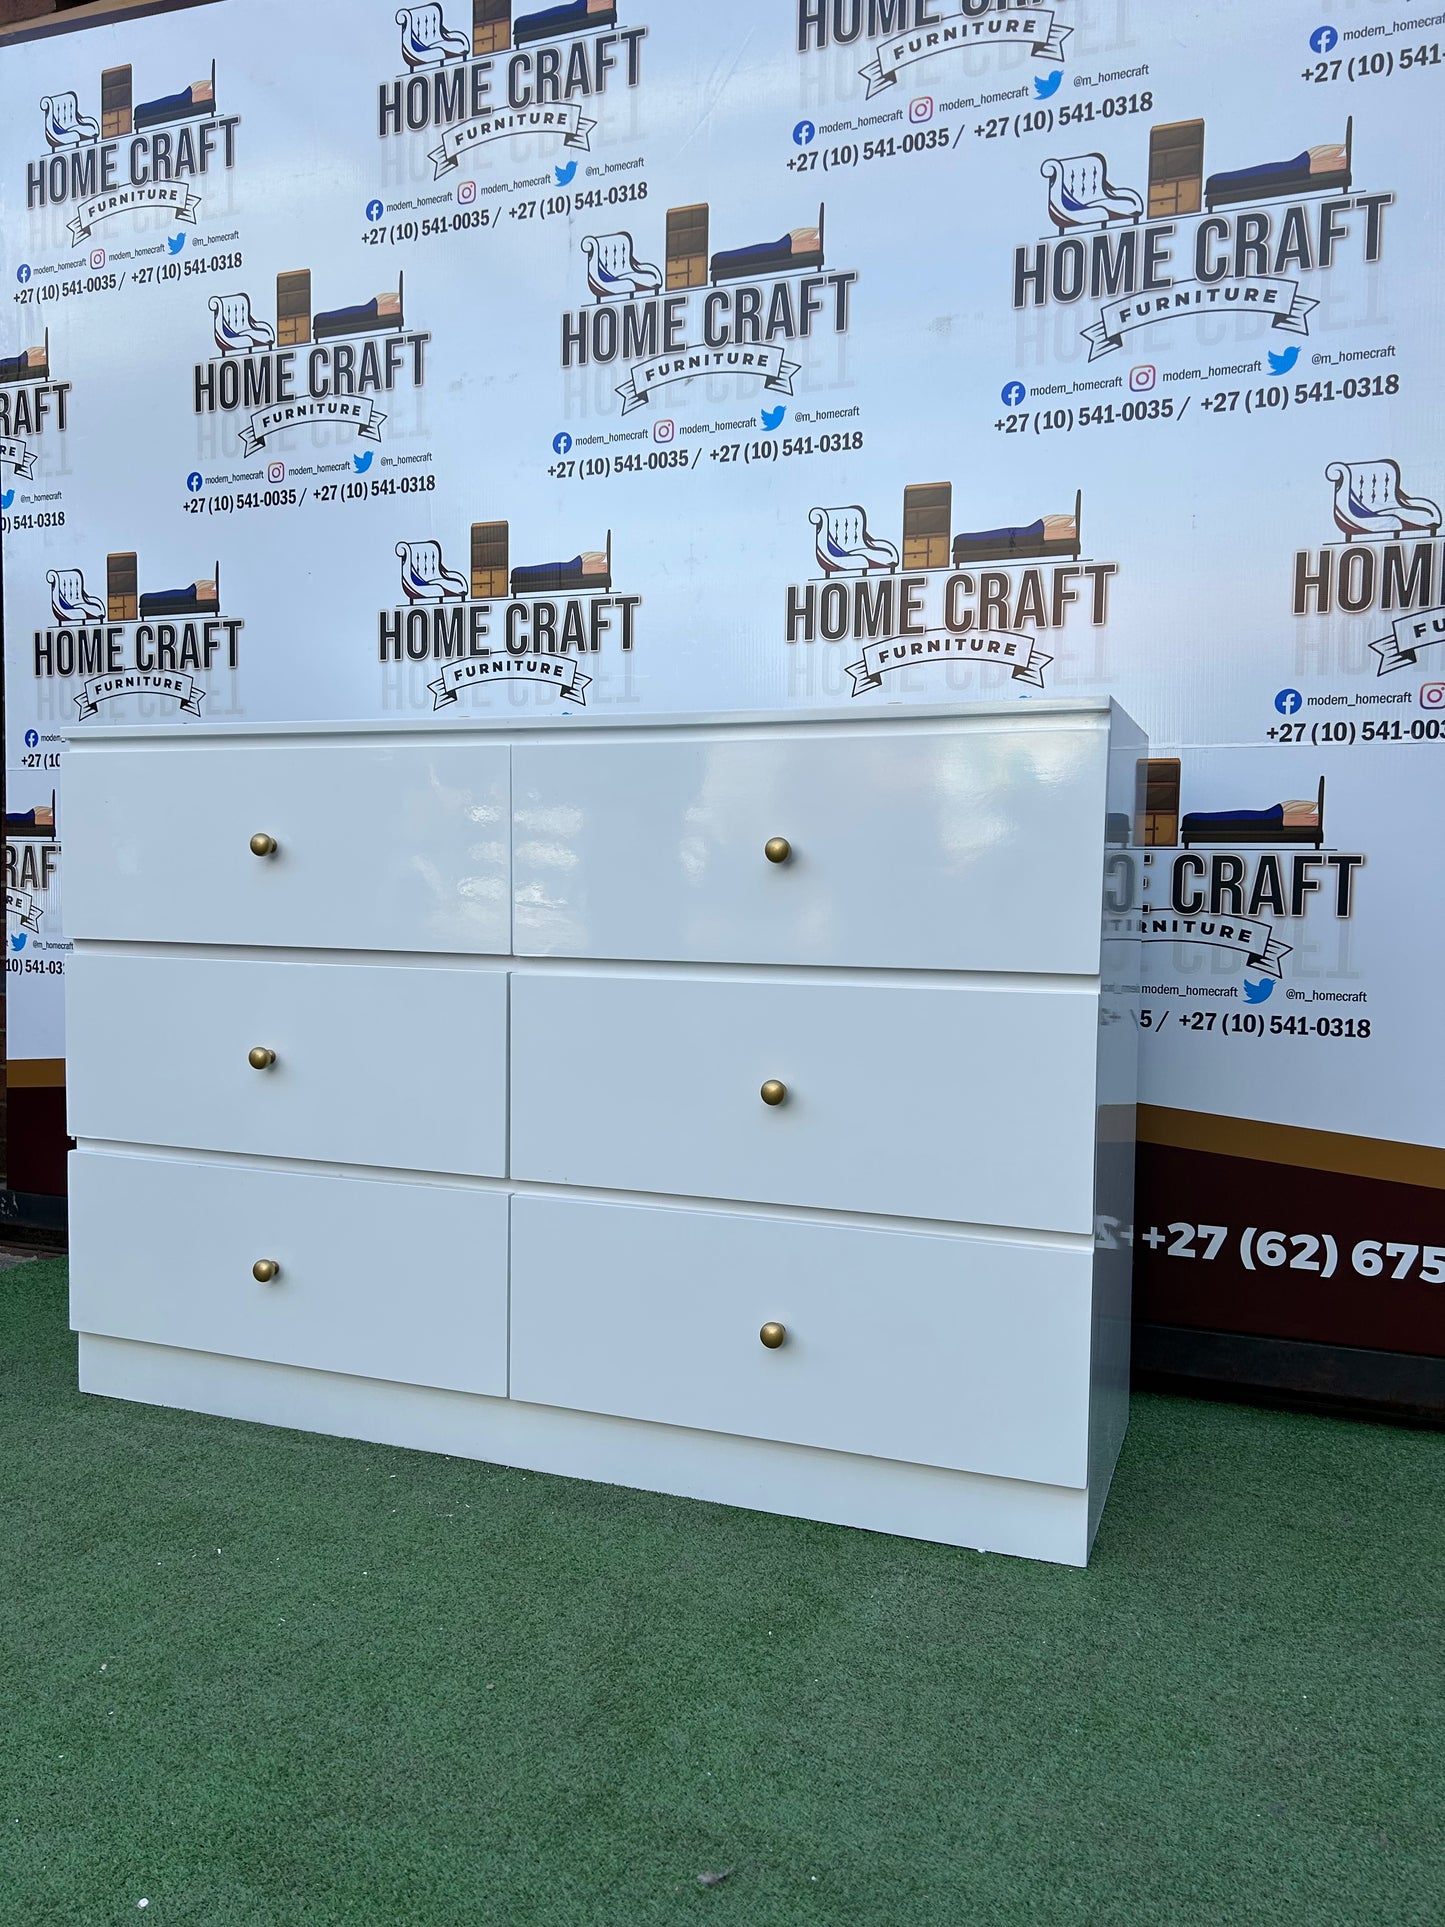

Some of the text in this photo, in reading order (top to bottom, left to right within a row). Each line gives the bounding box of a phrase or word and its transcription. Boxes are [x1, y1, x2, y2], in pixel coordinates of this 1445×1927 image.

[894, 19, 1036, 60] FURNITURE
[378, 27, 648, 138] HOME CRAFT
[1302, 60, 1342, 83] +27
[1347, 51, 1394, 82] (10)
[455, 112, 568, 146] FURNITURE
[786, 150, 819, 173] +27
[822, 144, 858, 172] (10)
[862, 127, 949, 160] 541-0035
[974, 117, 1009, 139] +27
[1014, 108, 1053, 138] (10)
[1058, 91, 1153, 126] 541-0318
[26, 115, 241, 209] HOME CRAFT
[88, 189, 178, 217] FURNITURE
[361, 226, 387, 245] +27
[390, 222, 418, 245] (10)
[421, 209, 490, 237] 541-0035
[508, 201, 536, 220] +27
[540, 195, 570, 219] (10)
[574, 181, 648, 210] 541-0318
[1014, 193, 1394, 308] HOME CRAFT
[13, 287, 34, 305] +27
[37, 284, 59, 304] (10)
[62, 273, 117, 298] 541-0035
[131, 267, 154, 284] +27
[156, 262, 181, 284] (10)
[184, 252, 242, 276] 541-0318
[561, 271, 857, 367] HOME CRAFT
[1119, 287, 1278, 323] FURNITURE
[194, 332, 430, 412] HOME CRAFT
[646, 352, 769, 382] FURNITURE
[263, 402, 361, 428] FURNITURE
[994, 412, 1029, 435] +27
[1033, 408, 1073, 435] (10)
[1078, 399, 1174, 427] 541-0035
[1201, 391, 1240, 414] +27
[1245, 385, 1289, 414] (10)
[1294, 374, 1400, 404] 541-0318
[547, 460, 575, 479] +27
[578, 456, 610, 480] (10)
[614, 448, 689, 475] 541-0035
[709, 444, 740, 464] +27
[743, 439, 778, 464] (10)
[782, 431, 863, 456] 541-0318
[183, 498, 205, 514] +27
[208, 495, 233, 515] (10)
[236, 488, 296, 510] 541-0035
[313, 484, 338, 501] +27
[340, 481, 367, 502] (10)
[371, 474, 435, 497] 541-0318
[13, 511, 65, 530] 541-0318
[786, 563, 1118, 644] HOME CRAFT
[1292, 543, 1445, 616] HOM
[34, 619, 244, 677] HOME CRAFT
[379, 595, 641, 661] HOME CRAFT
[879, 638, 1017, 663] FURNITURE
[95, 676, 183, 694] FURNITURE
[454, 660, 563, 681] FURNITURE
[1266, 723, 1306, 742] +27
[1311, 721, 1356, 745] (10)
[21, 753, 42, 767] +27
[1171, 853, 1364, 918] CRAFT
[1179, 1012, 1217, 1031] +27
[1222, 1013, 1264, 1037] (10)
[1270, 1015, 1371, 1039] 541-0318
[1142, 1221, 1228, 1261] +27
[1239, 1226, 1339, 1279] (62)
